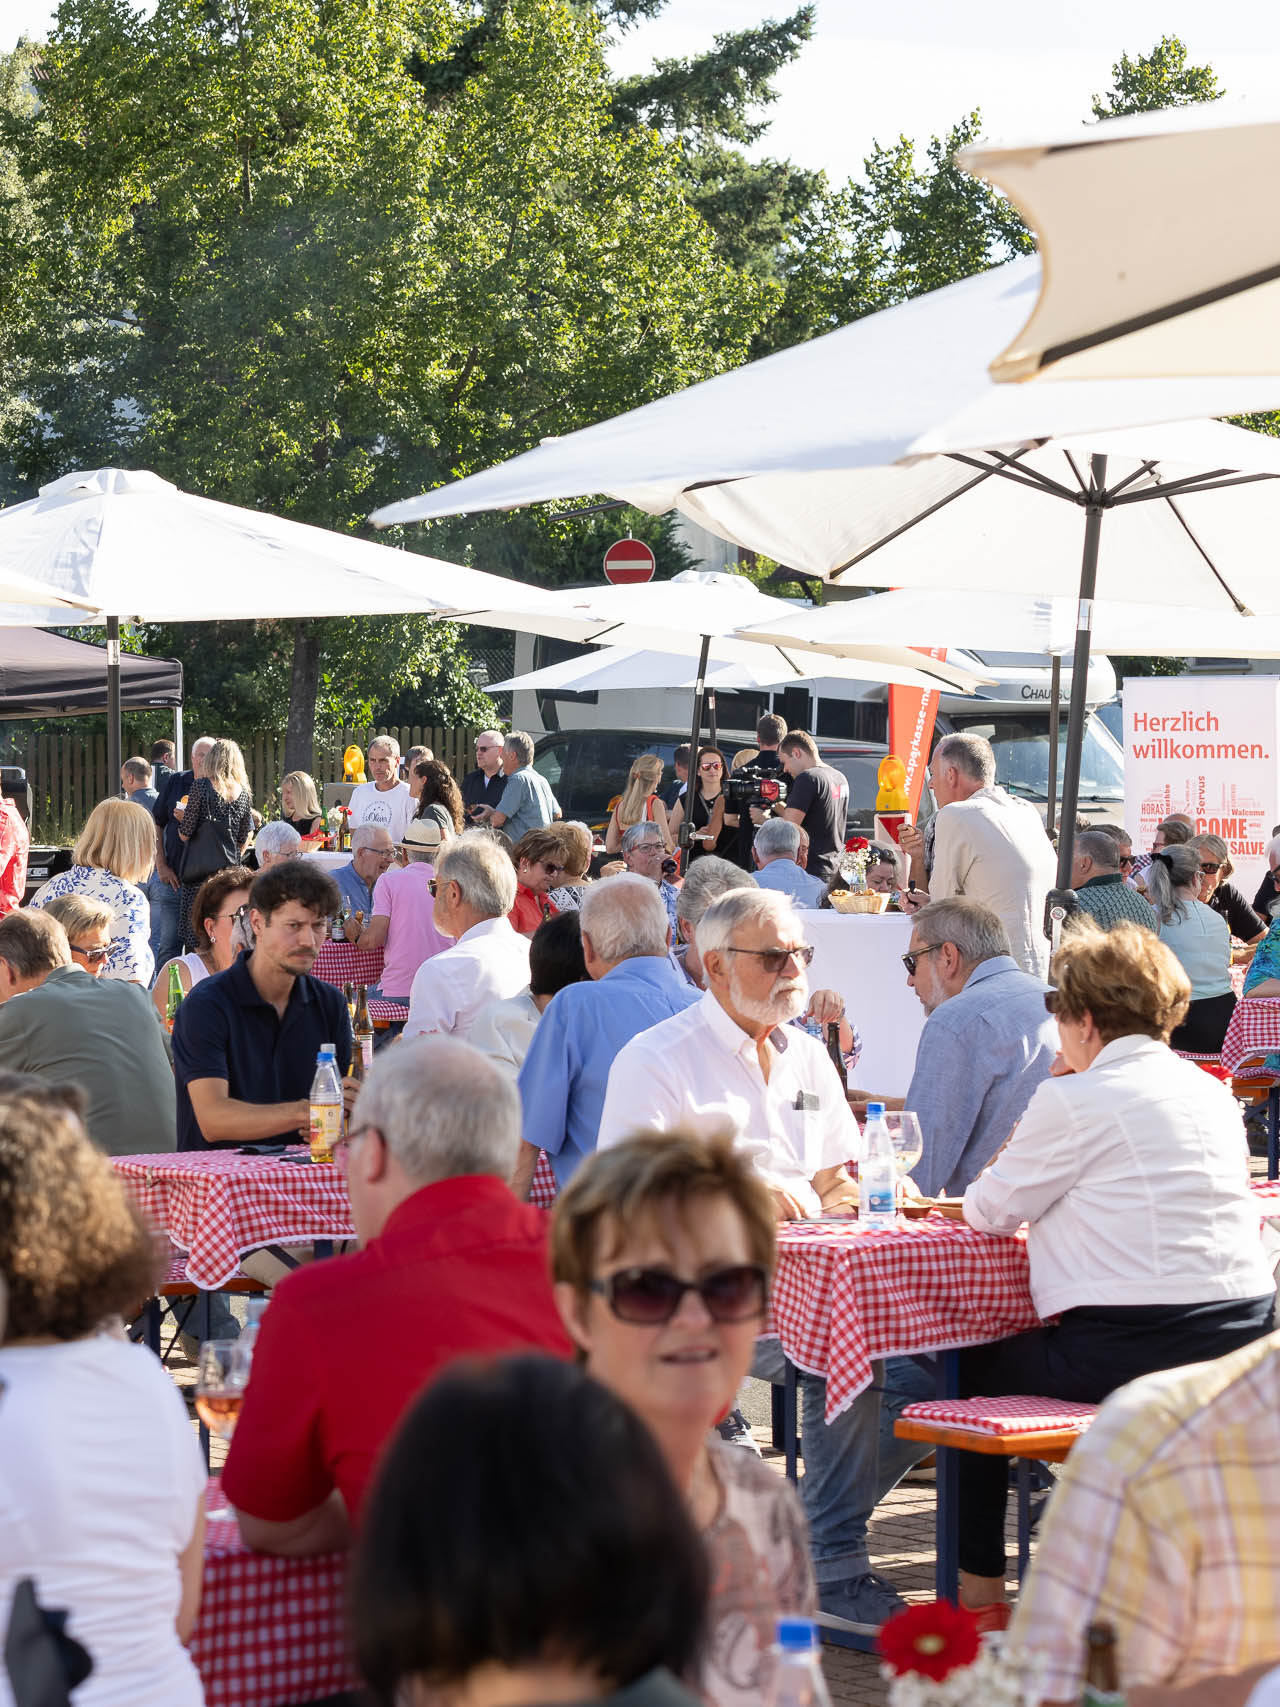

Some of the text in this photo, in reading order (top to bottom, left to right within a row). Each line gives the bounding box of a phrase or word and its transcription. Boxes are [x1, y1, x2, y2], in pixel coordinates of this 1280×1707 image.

[1133, 711, 1219, 732] Herzlich
[1132, 738, 1270, 759] willkommen.
[1196, 775, 1206, 815] Servus
[1141, 803, 1165, 815] HORAS
[1195, 817, 1248, 839] COME
[1230, 841, 1265, 855] SALVE
